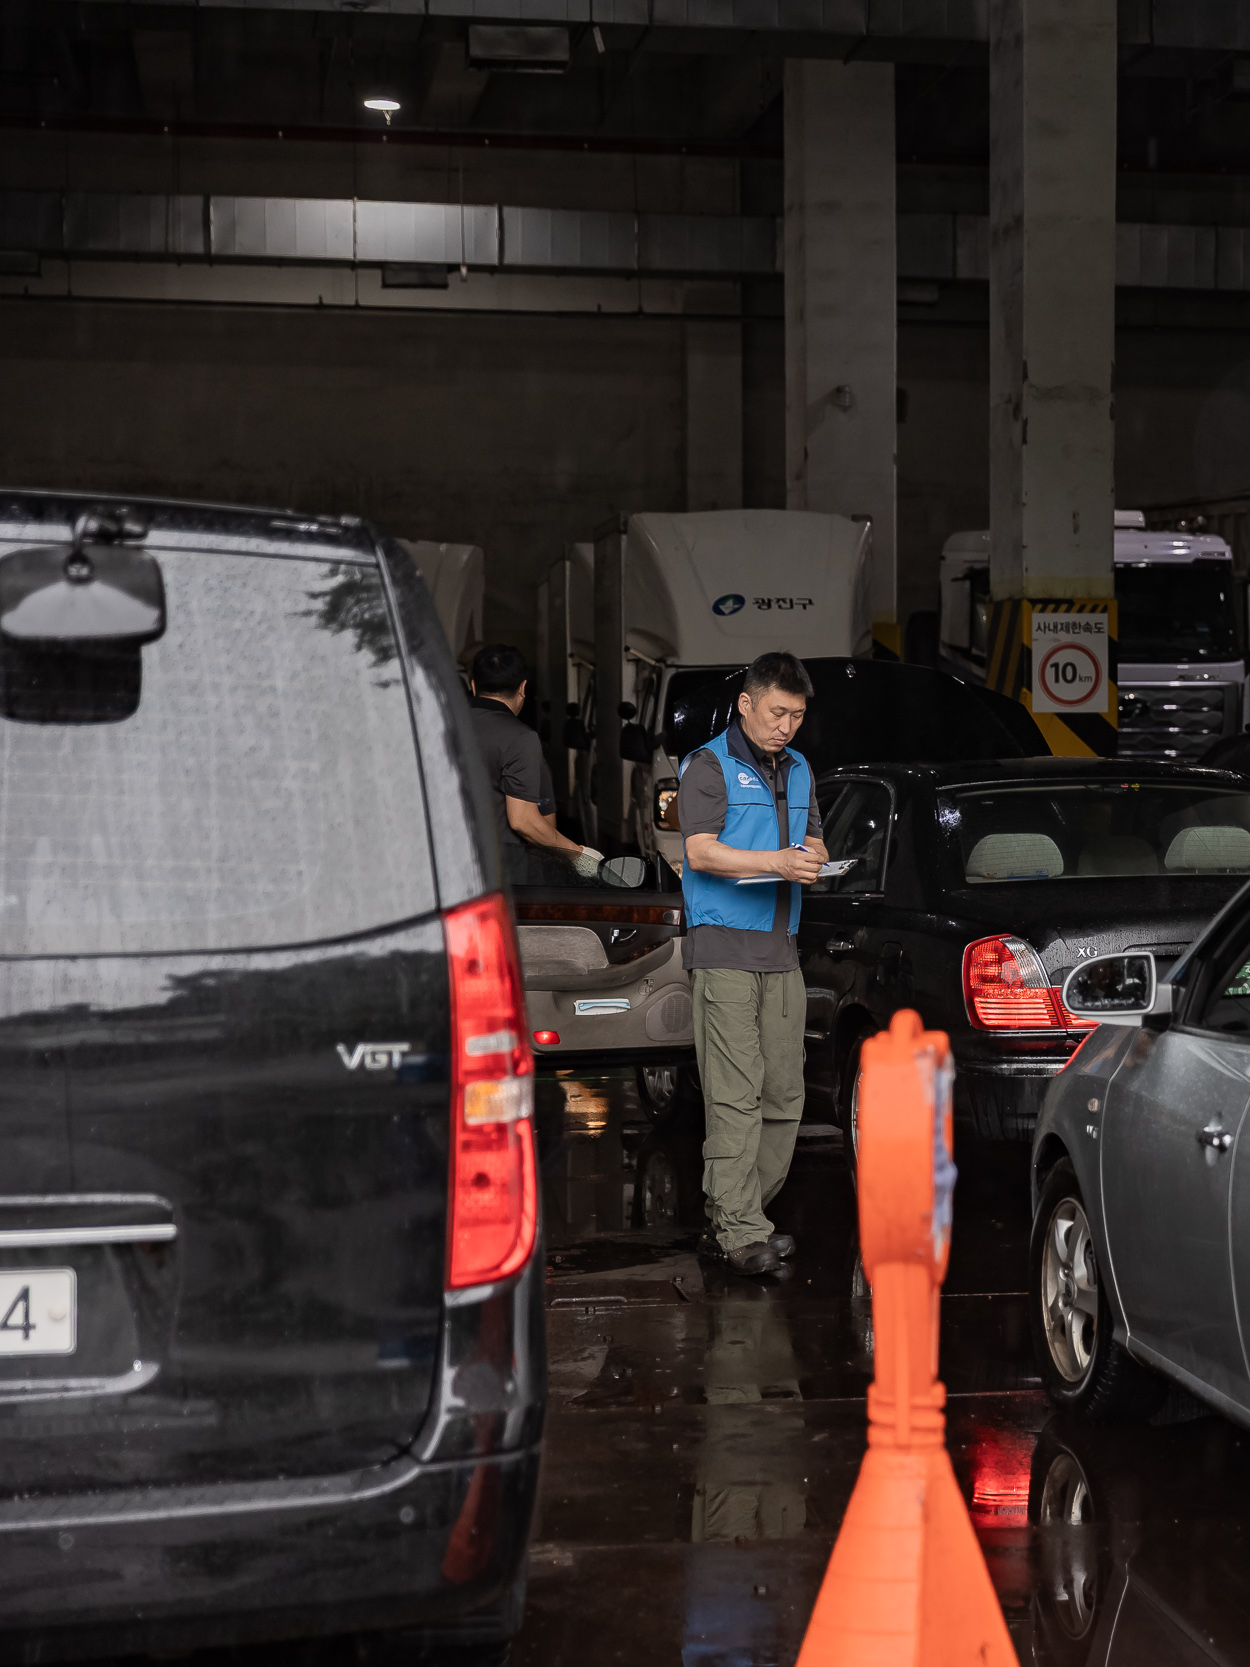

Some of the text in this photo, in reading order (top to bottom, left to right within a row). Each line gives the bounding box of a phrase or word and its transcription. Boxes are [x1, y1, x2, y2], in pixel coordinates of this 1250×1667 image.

[752, 597, 814, 611] 광진구
[1035, 621, 1106, 635] 사내제한속도
[1077, 946, 1099, 958] XG
[336, 1042, 411, 1070] VGT
[0, 1285, 37, 1341] 4
